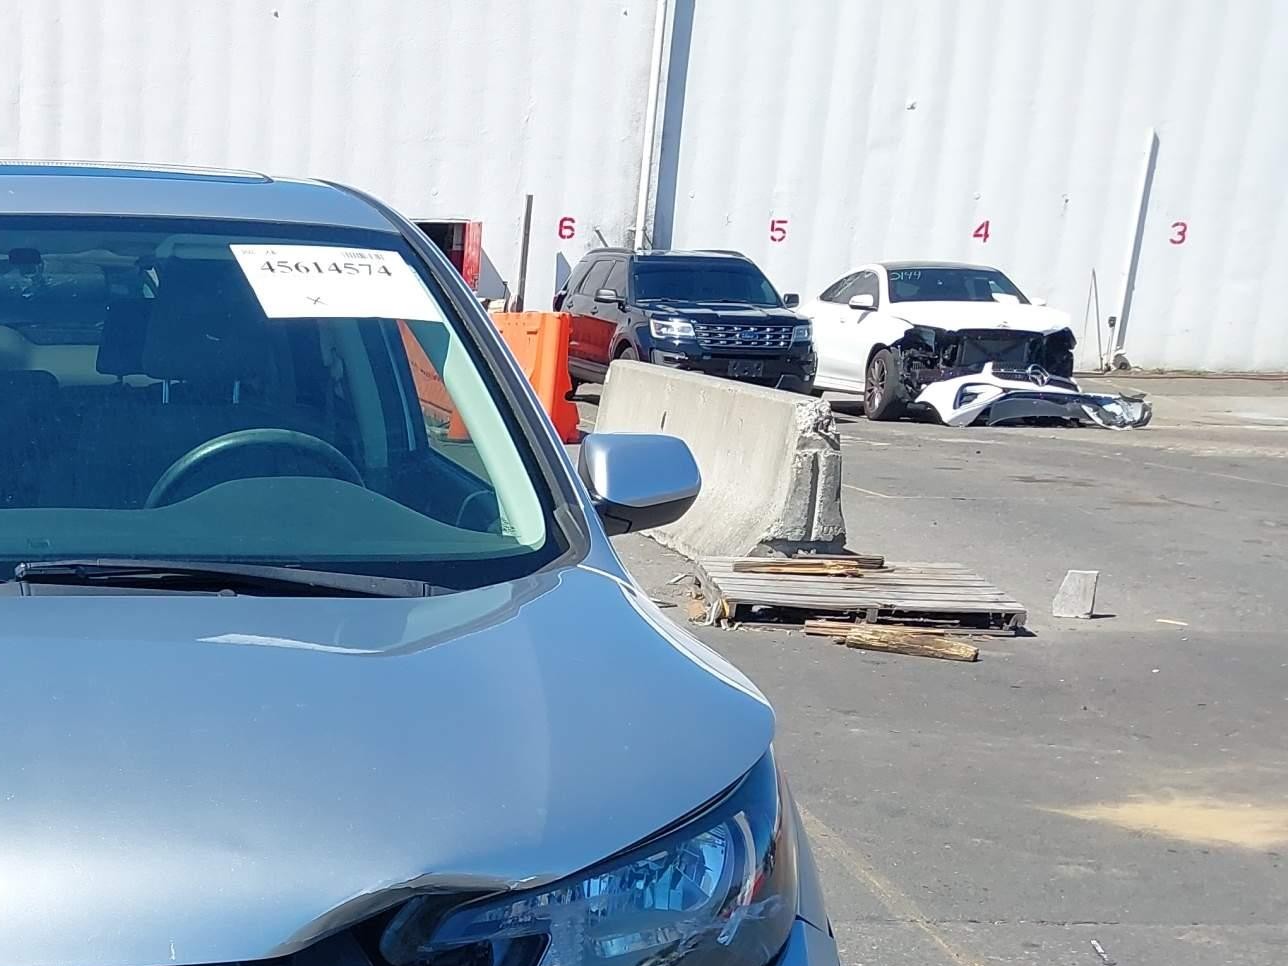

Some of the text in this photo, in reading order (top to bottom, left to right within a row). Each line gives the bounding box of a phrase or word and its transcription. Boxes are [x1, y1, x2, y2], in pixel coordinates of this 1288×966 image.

[558, 216, 576, 239] 6
[770, 219, 788, 242] 5
[973, 220, 990, 243] 4
[1169, 222, 1188, 244] 3
[260, 260, 393, 277] 45614574
